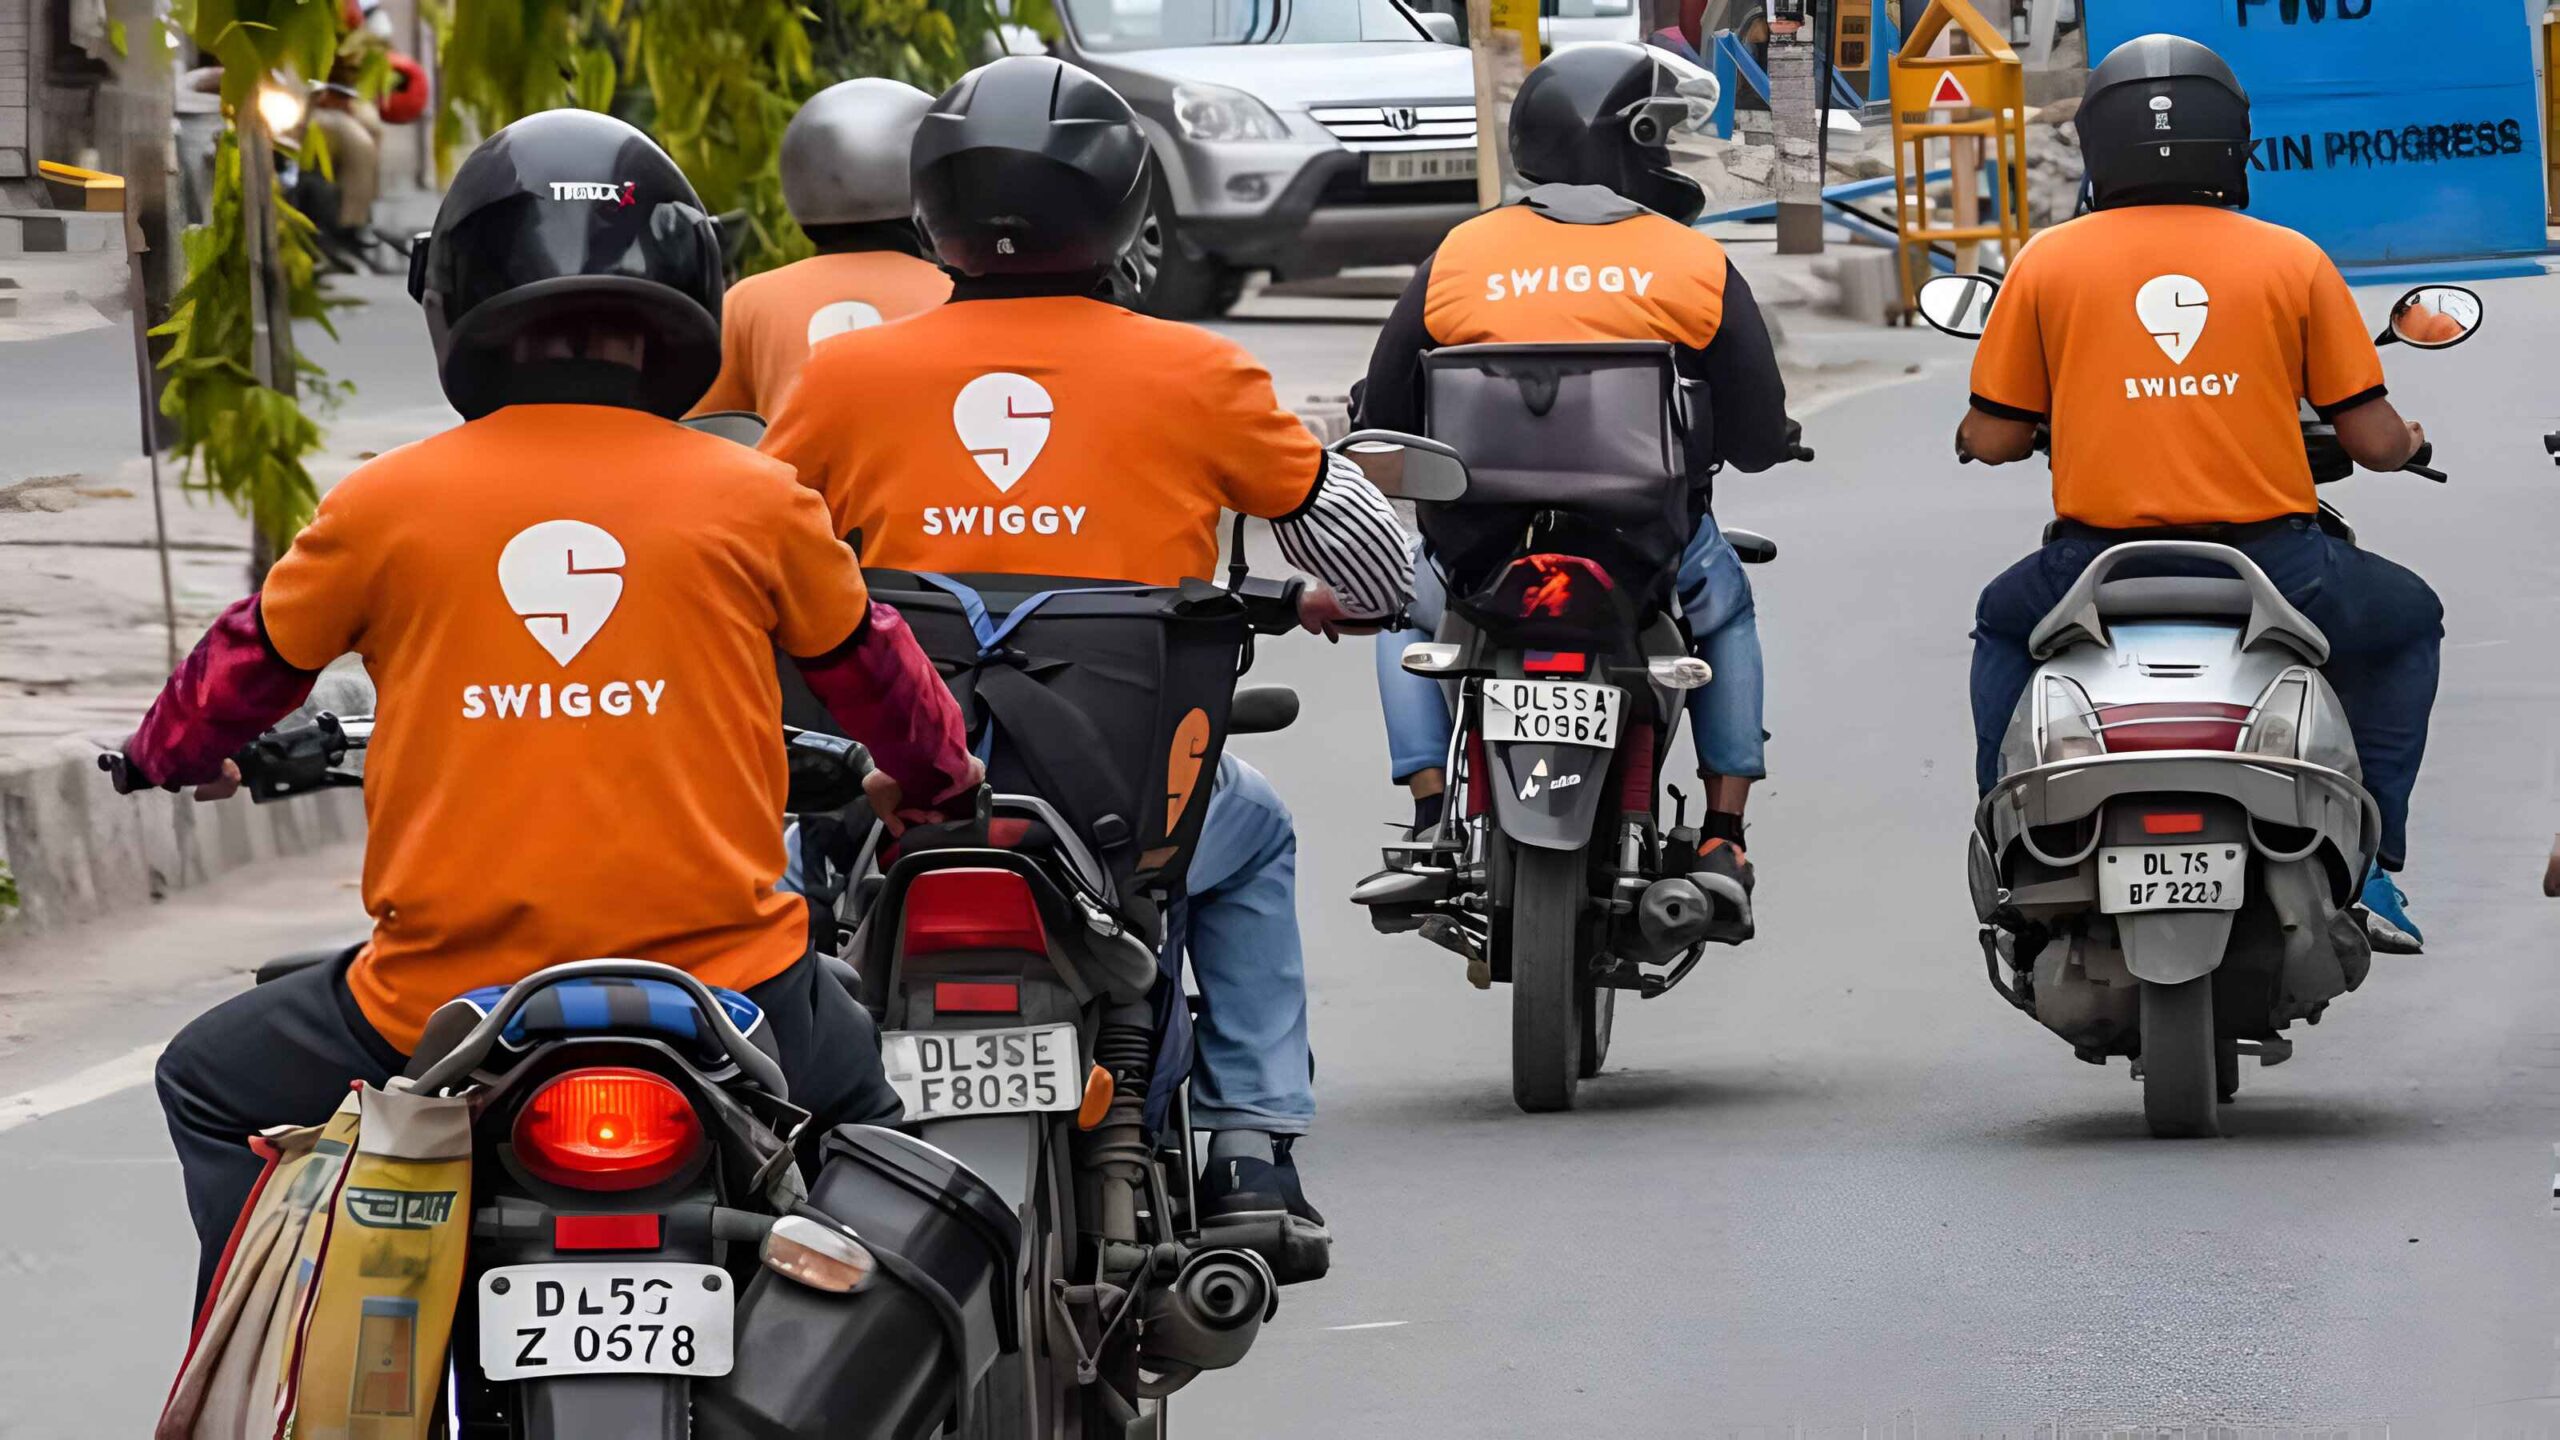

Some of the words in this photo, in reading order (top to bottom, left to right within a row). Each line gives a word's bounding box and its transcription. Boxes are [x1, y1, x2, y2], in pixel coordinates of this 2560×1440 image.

[2324, 118, 2522, 169] PROGRESS
[1486, 265, 1654, 301] SWIGGY
[2125, 373, 2239, 398] SWIGGY
[922, 505, 1086, 536] SWIGGY
[462, 680, 665, 719] SWIGGY
[921, 1071, 1056, 1112] F8035
